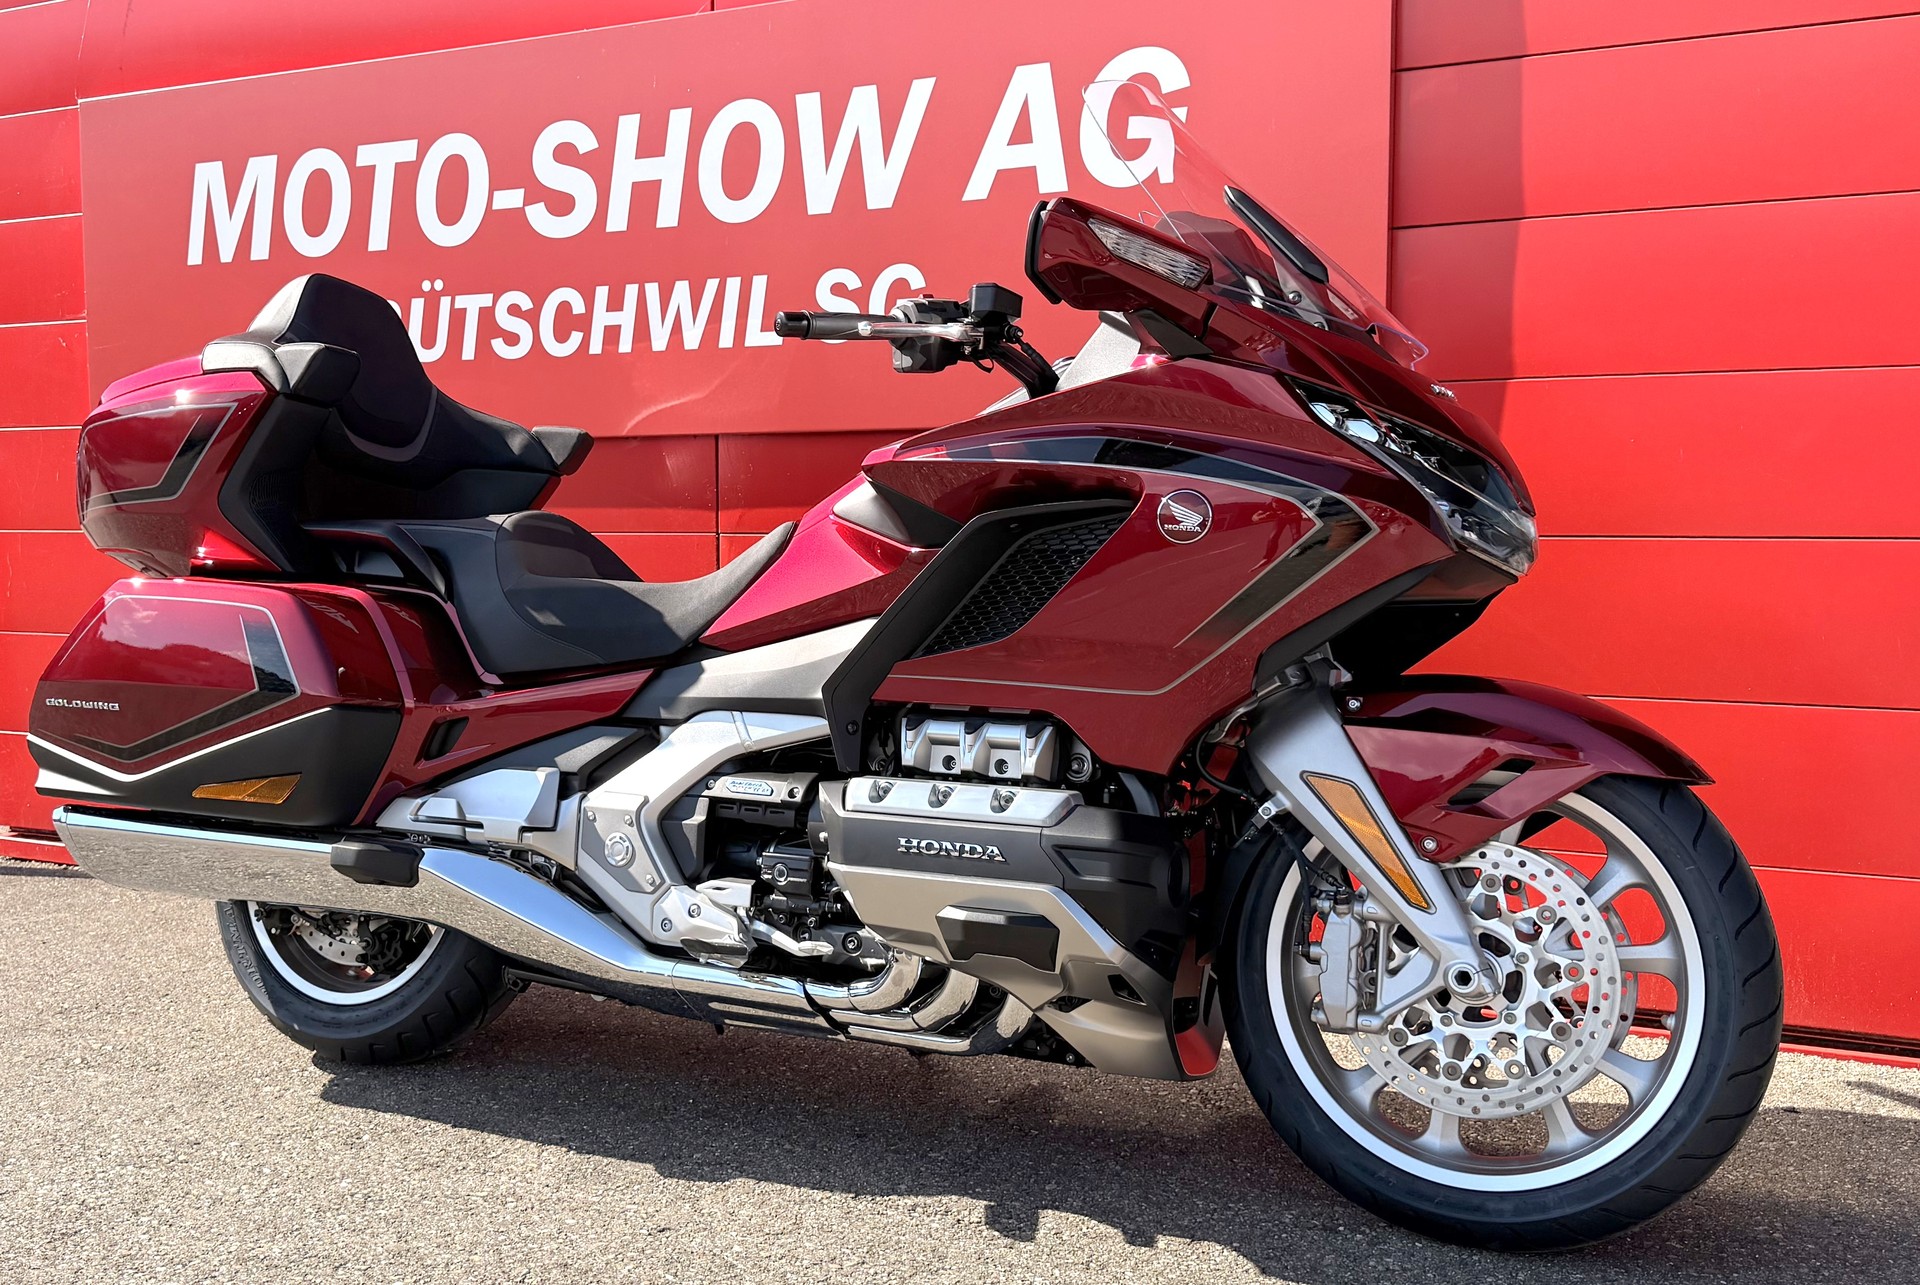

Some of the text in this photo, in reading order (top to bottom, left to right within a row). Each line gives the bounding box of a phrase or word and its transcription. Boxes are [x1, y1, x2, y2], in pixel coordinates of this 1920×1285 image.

[188, 46, 1192, 266] MOTO-SHOW AG
[387, 274, 784, 363] ÜTSCHWIL
[1163, 524, 1203, 533] HONDA
[45, 698, 120, 711] GOLDWING
[897, 837, 1006, 862] HONDA
